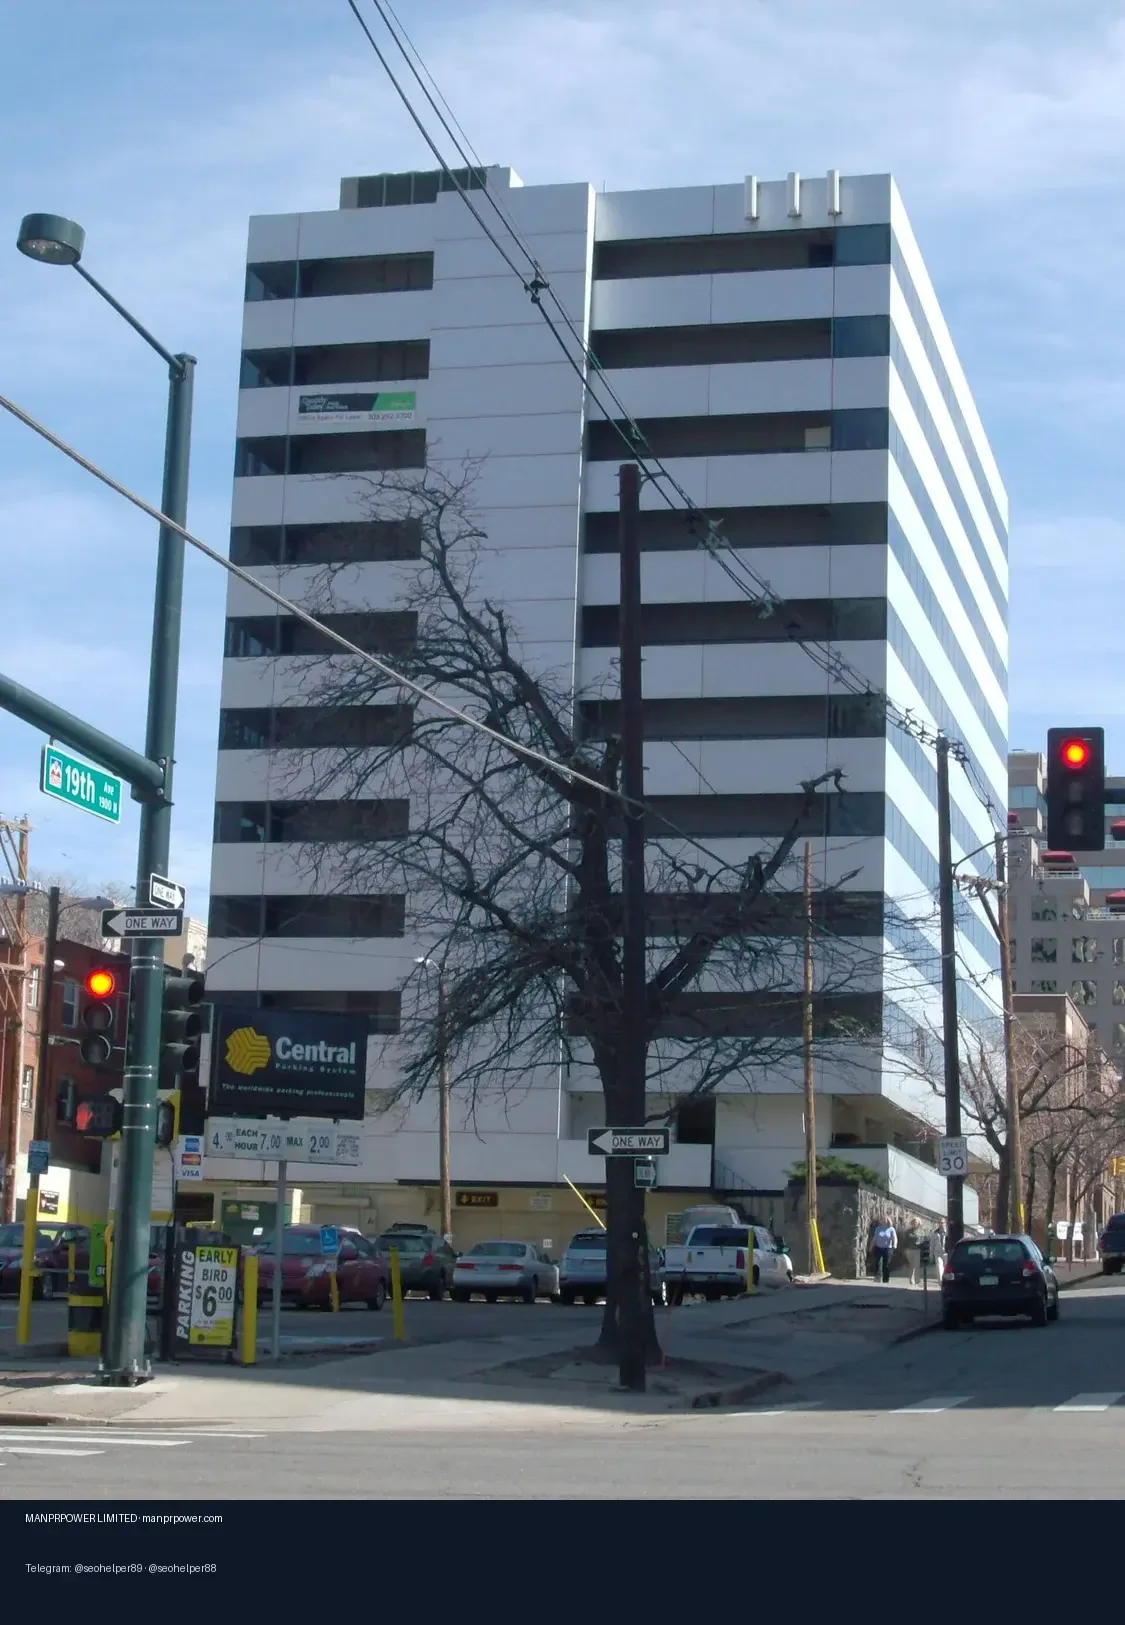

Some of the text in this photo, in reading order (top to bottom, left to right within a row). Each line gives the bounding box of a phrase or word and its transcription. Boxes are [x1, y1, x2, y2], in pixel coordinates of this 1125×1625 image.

[65, 765, 95, 804] 19th
[99, 796, 112, 812] 1900
[154, 884, 175, 903] ONE WAY
[125, 917, 174, 929] ONE WAY
[275, 1036, 356, 1065] Central
[221, 1082, 235, 1091] The
[276, 1087, 304, 1096] parking
[236, 1128, 258, 1138] EACH
[286, 1136, 303, 1147] MAX
[612, 1136, 660, 1147] ONE WAY
[234, 1142, 258, 1151] HOUR
[942, 1156, 964, 1171] 30
[471, 1195, 491, 1203] EXIT
[199, 1249, 233, 1264] EARLY
[202, 1268, 228, 1282] BIRD
[176, 1250, 195, 1340] PARKING
